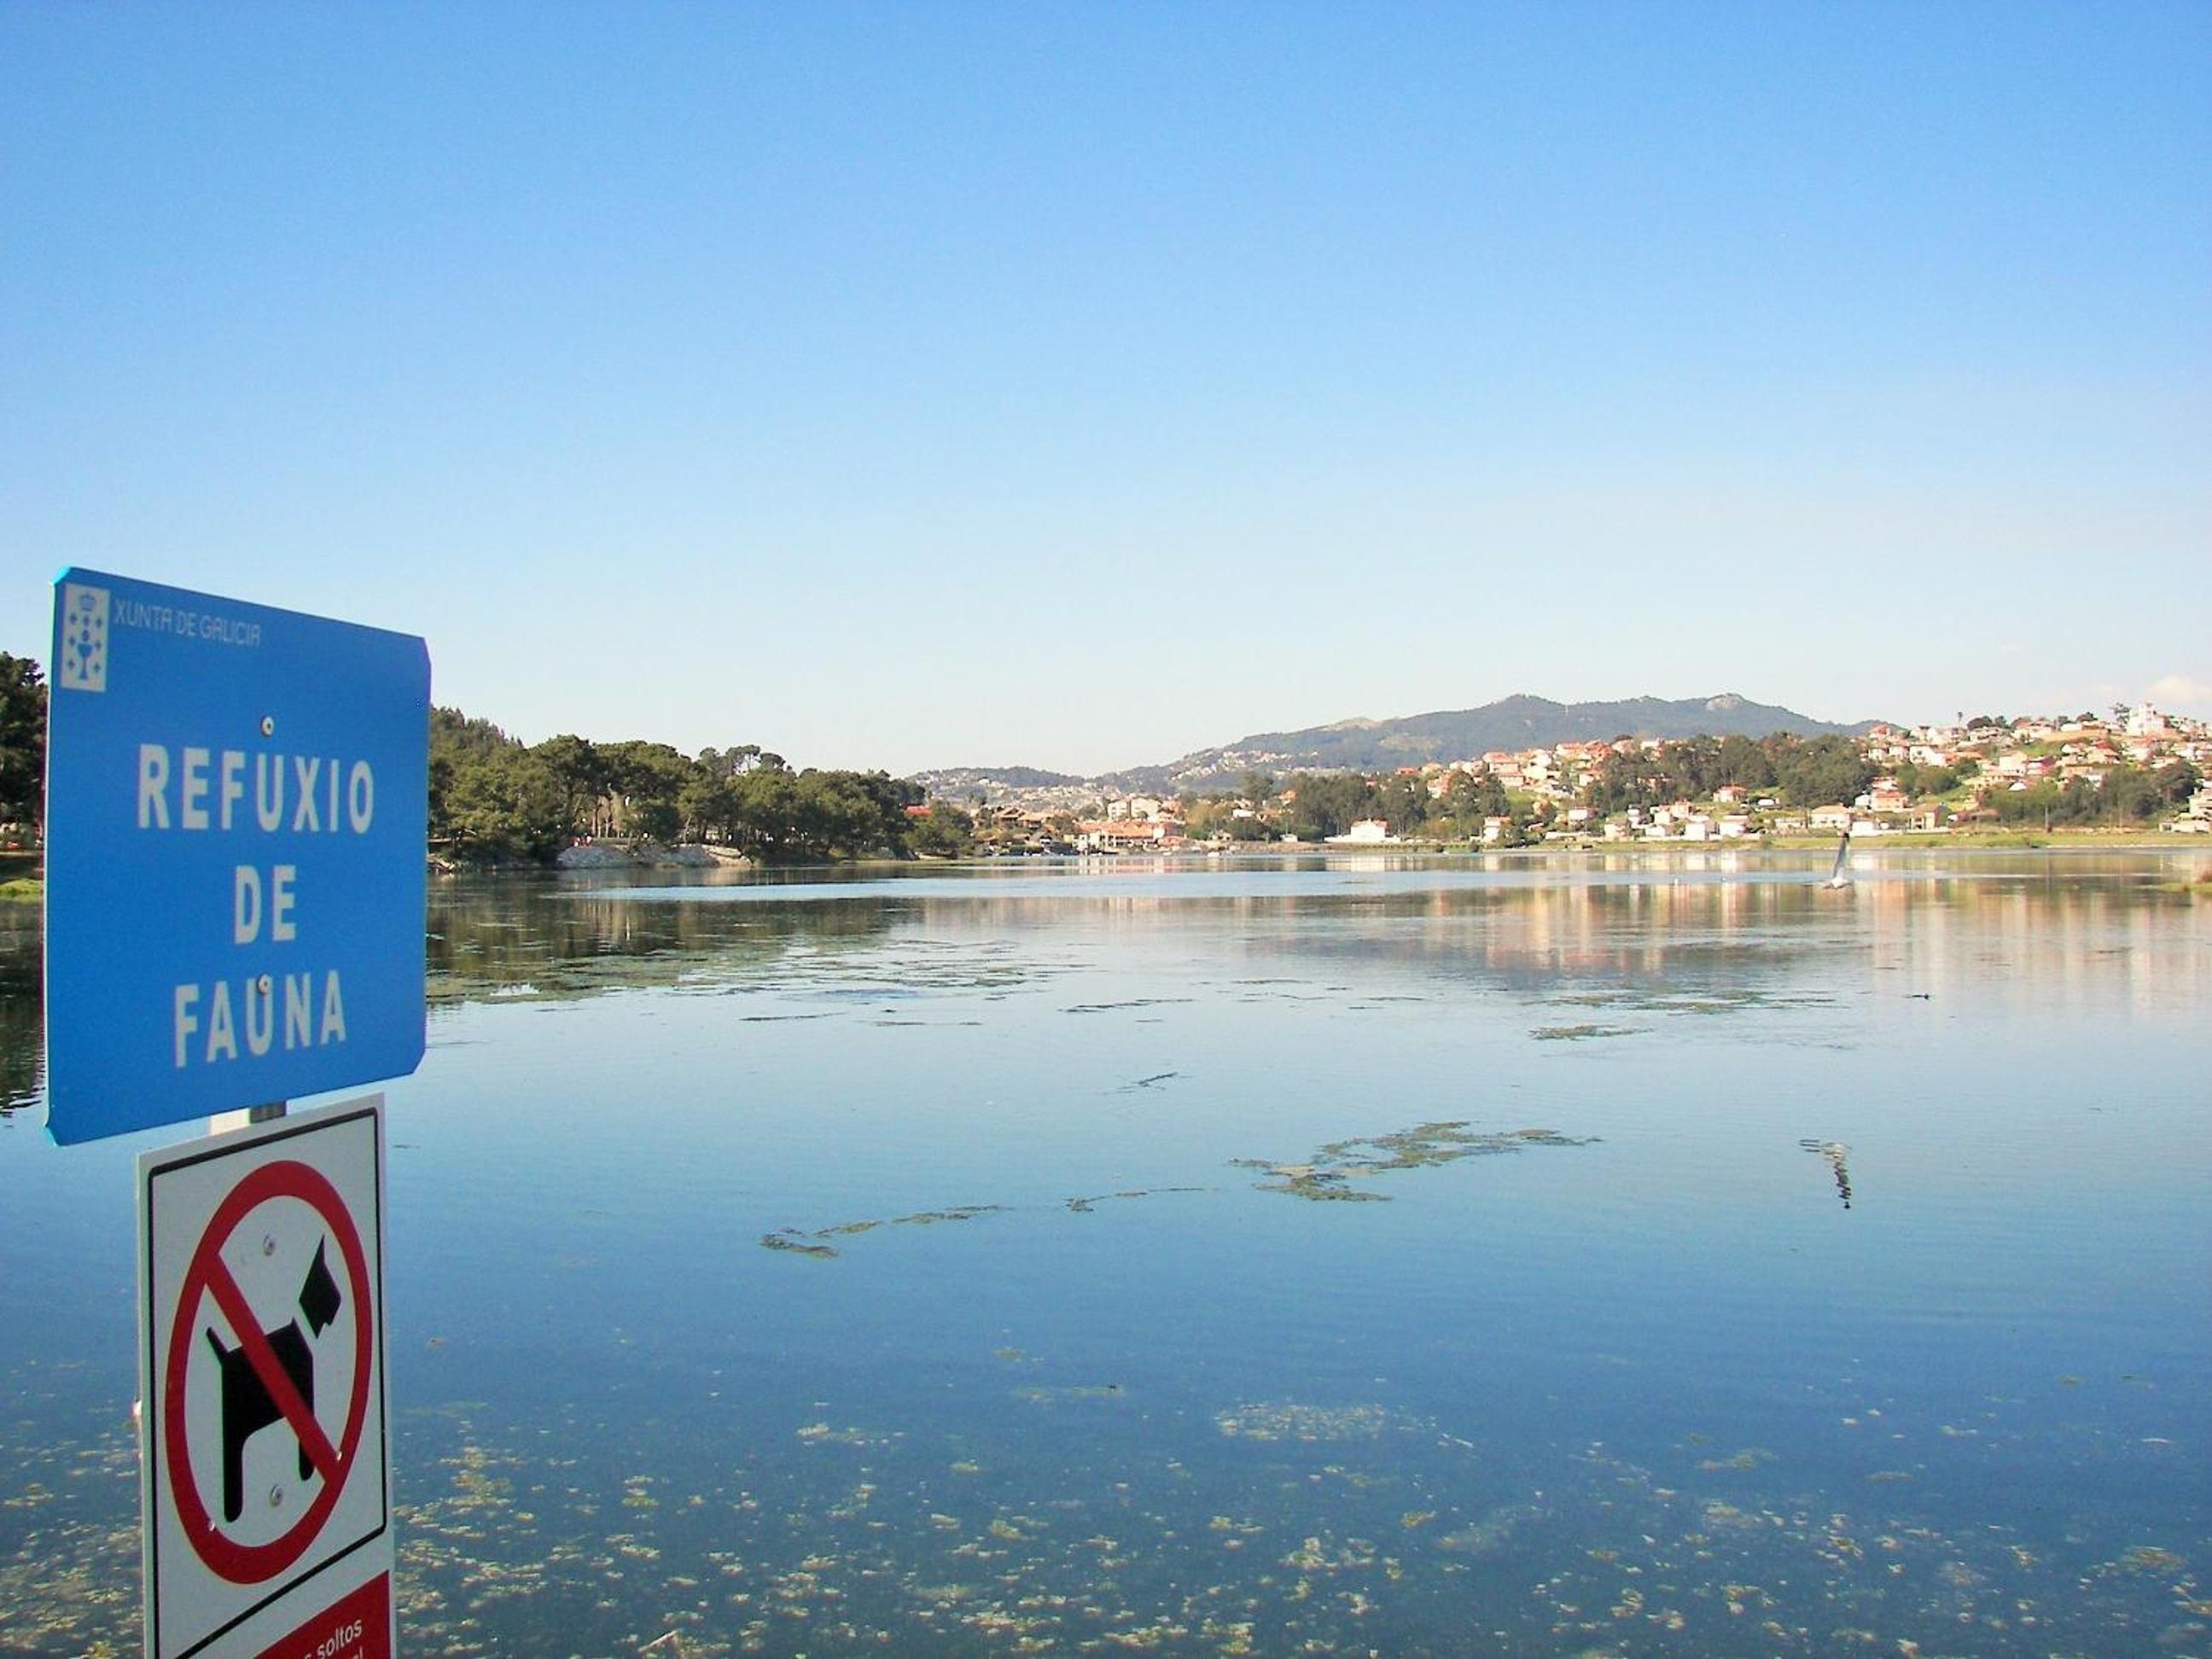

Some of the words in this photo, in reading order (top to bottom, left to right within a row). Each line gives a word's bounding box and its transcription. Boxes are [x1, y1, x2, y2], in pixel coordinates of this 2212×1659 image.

[114, 599, 172, 632] XUNTA
[176, 610, 197, 637] DE
[200, 614, 260, 648] GALICIA
[138, 743, 374, 834] REFUXIO
[234, 864, 296, 945] DE
[175, 969, 346, 1068] FAUNA
[317, 1620, 362, 1659] soltos
